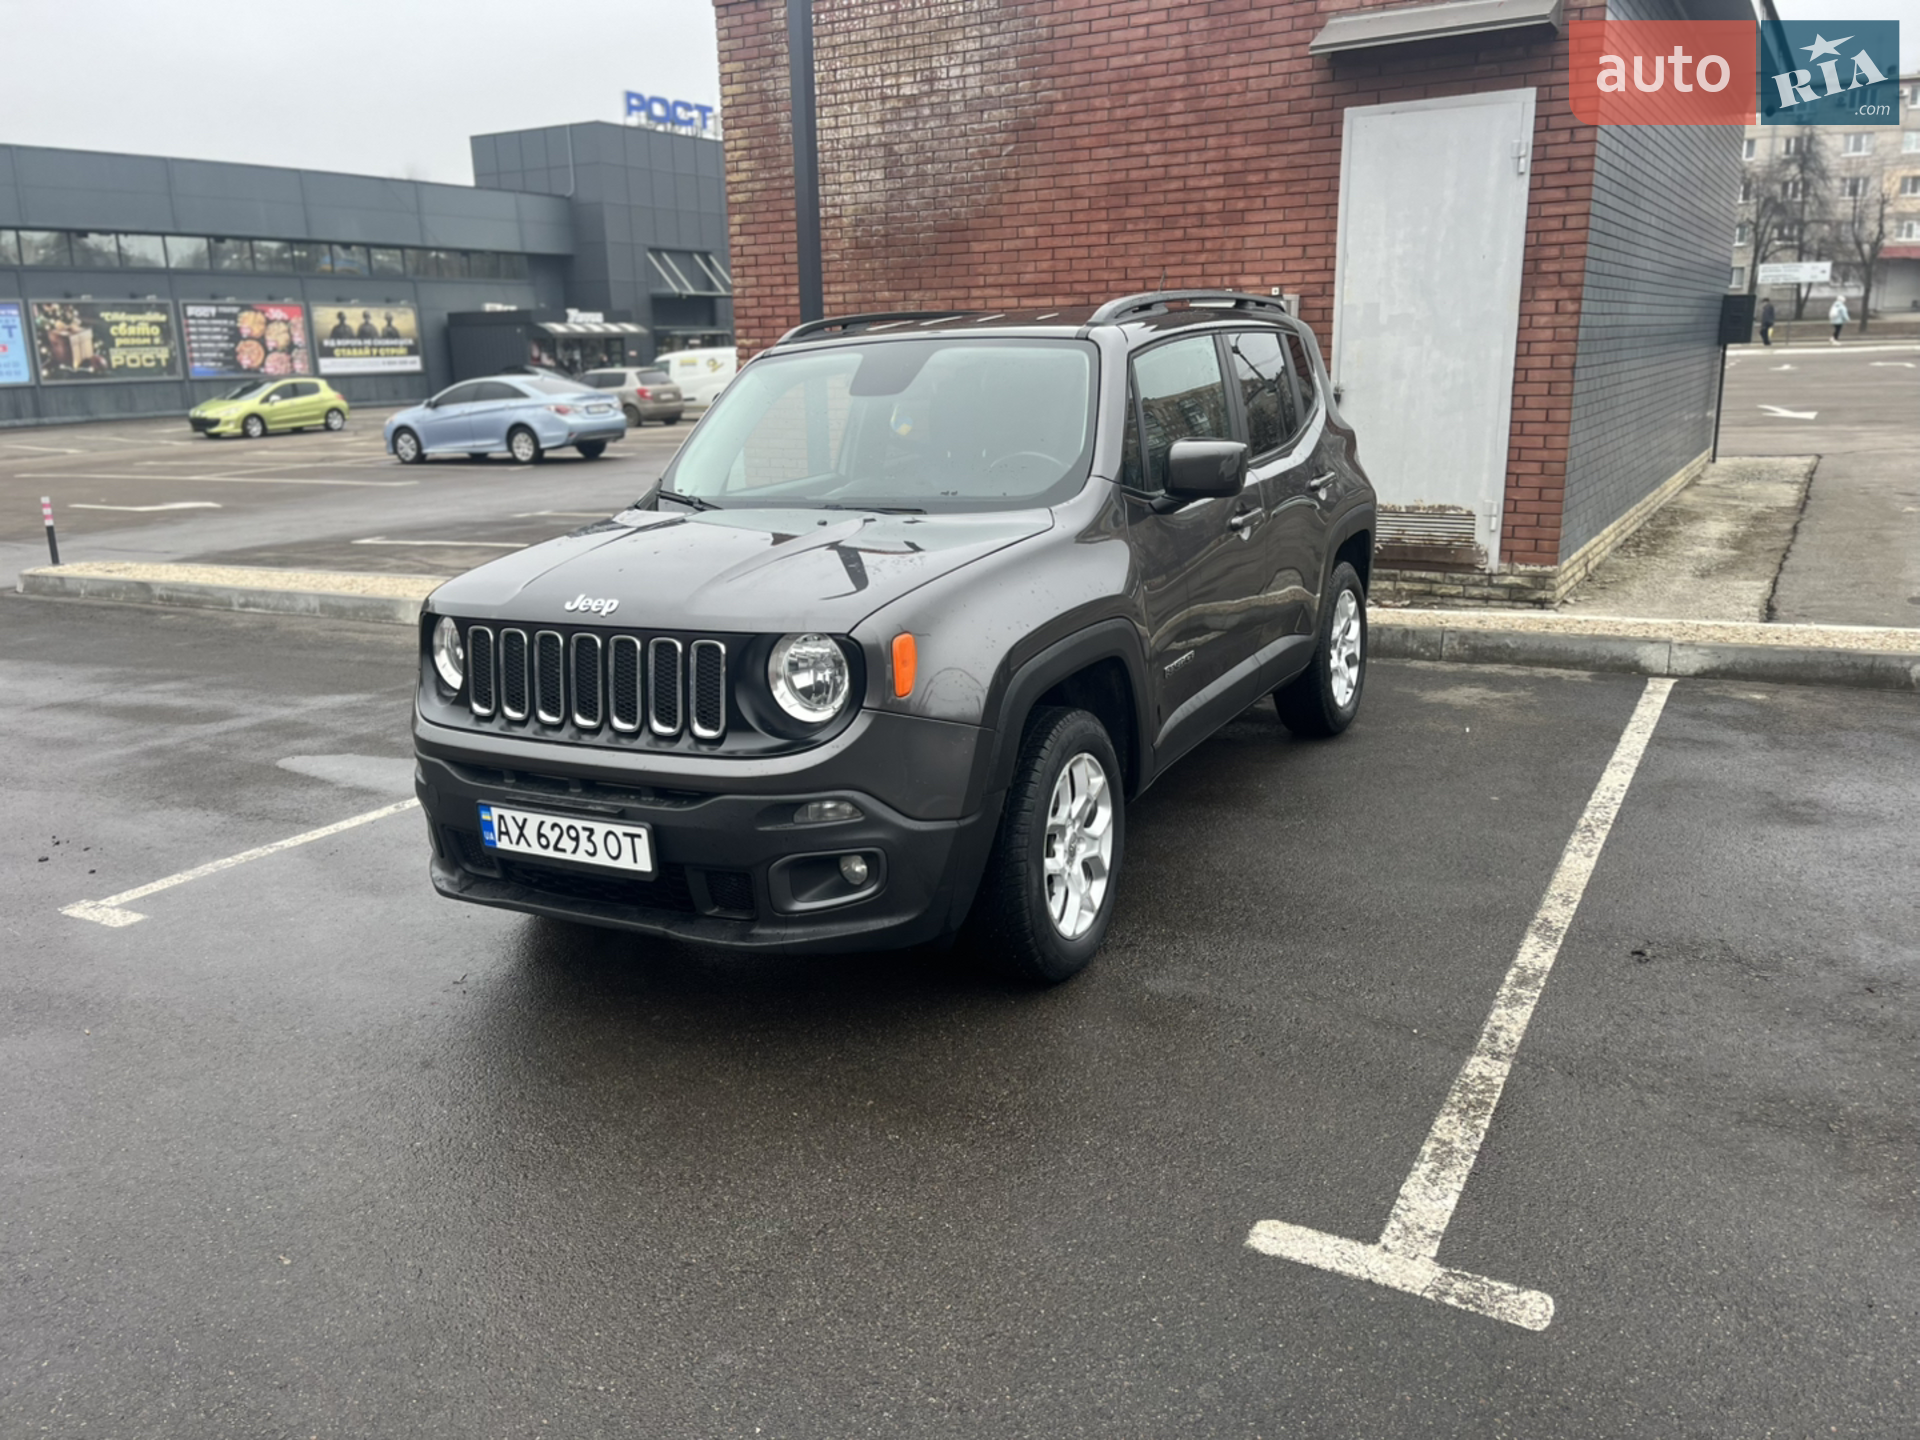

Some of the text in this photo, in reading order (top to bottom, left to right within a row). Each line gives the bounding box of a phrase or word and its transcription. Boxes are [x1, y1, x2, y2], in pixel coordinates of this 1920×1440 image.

[624, 90, 713, 130] РОСТ
[111, 355, 169, 369] РОСТ
[564, 594, 620, 617] Jeep
[497, 814, 642, 864] AX 6293 OT
